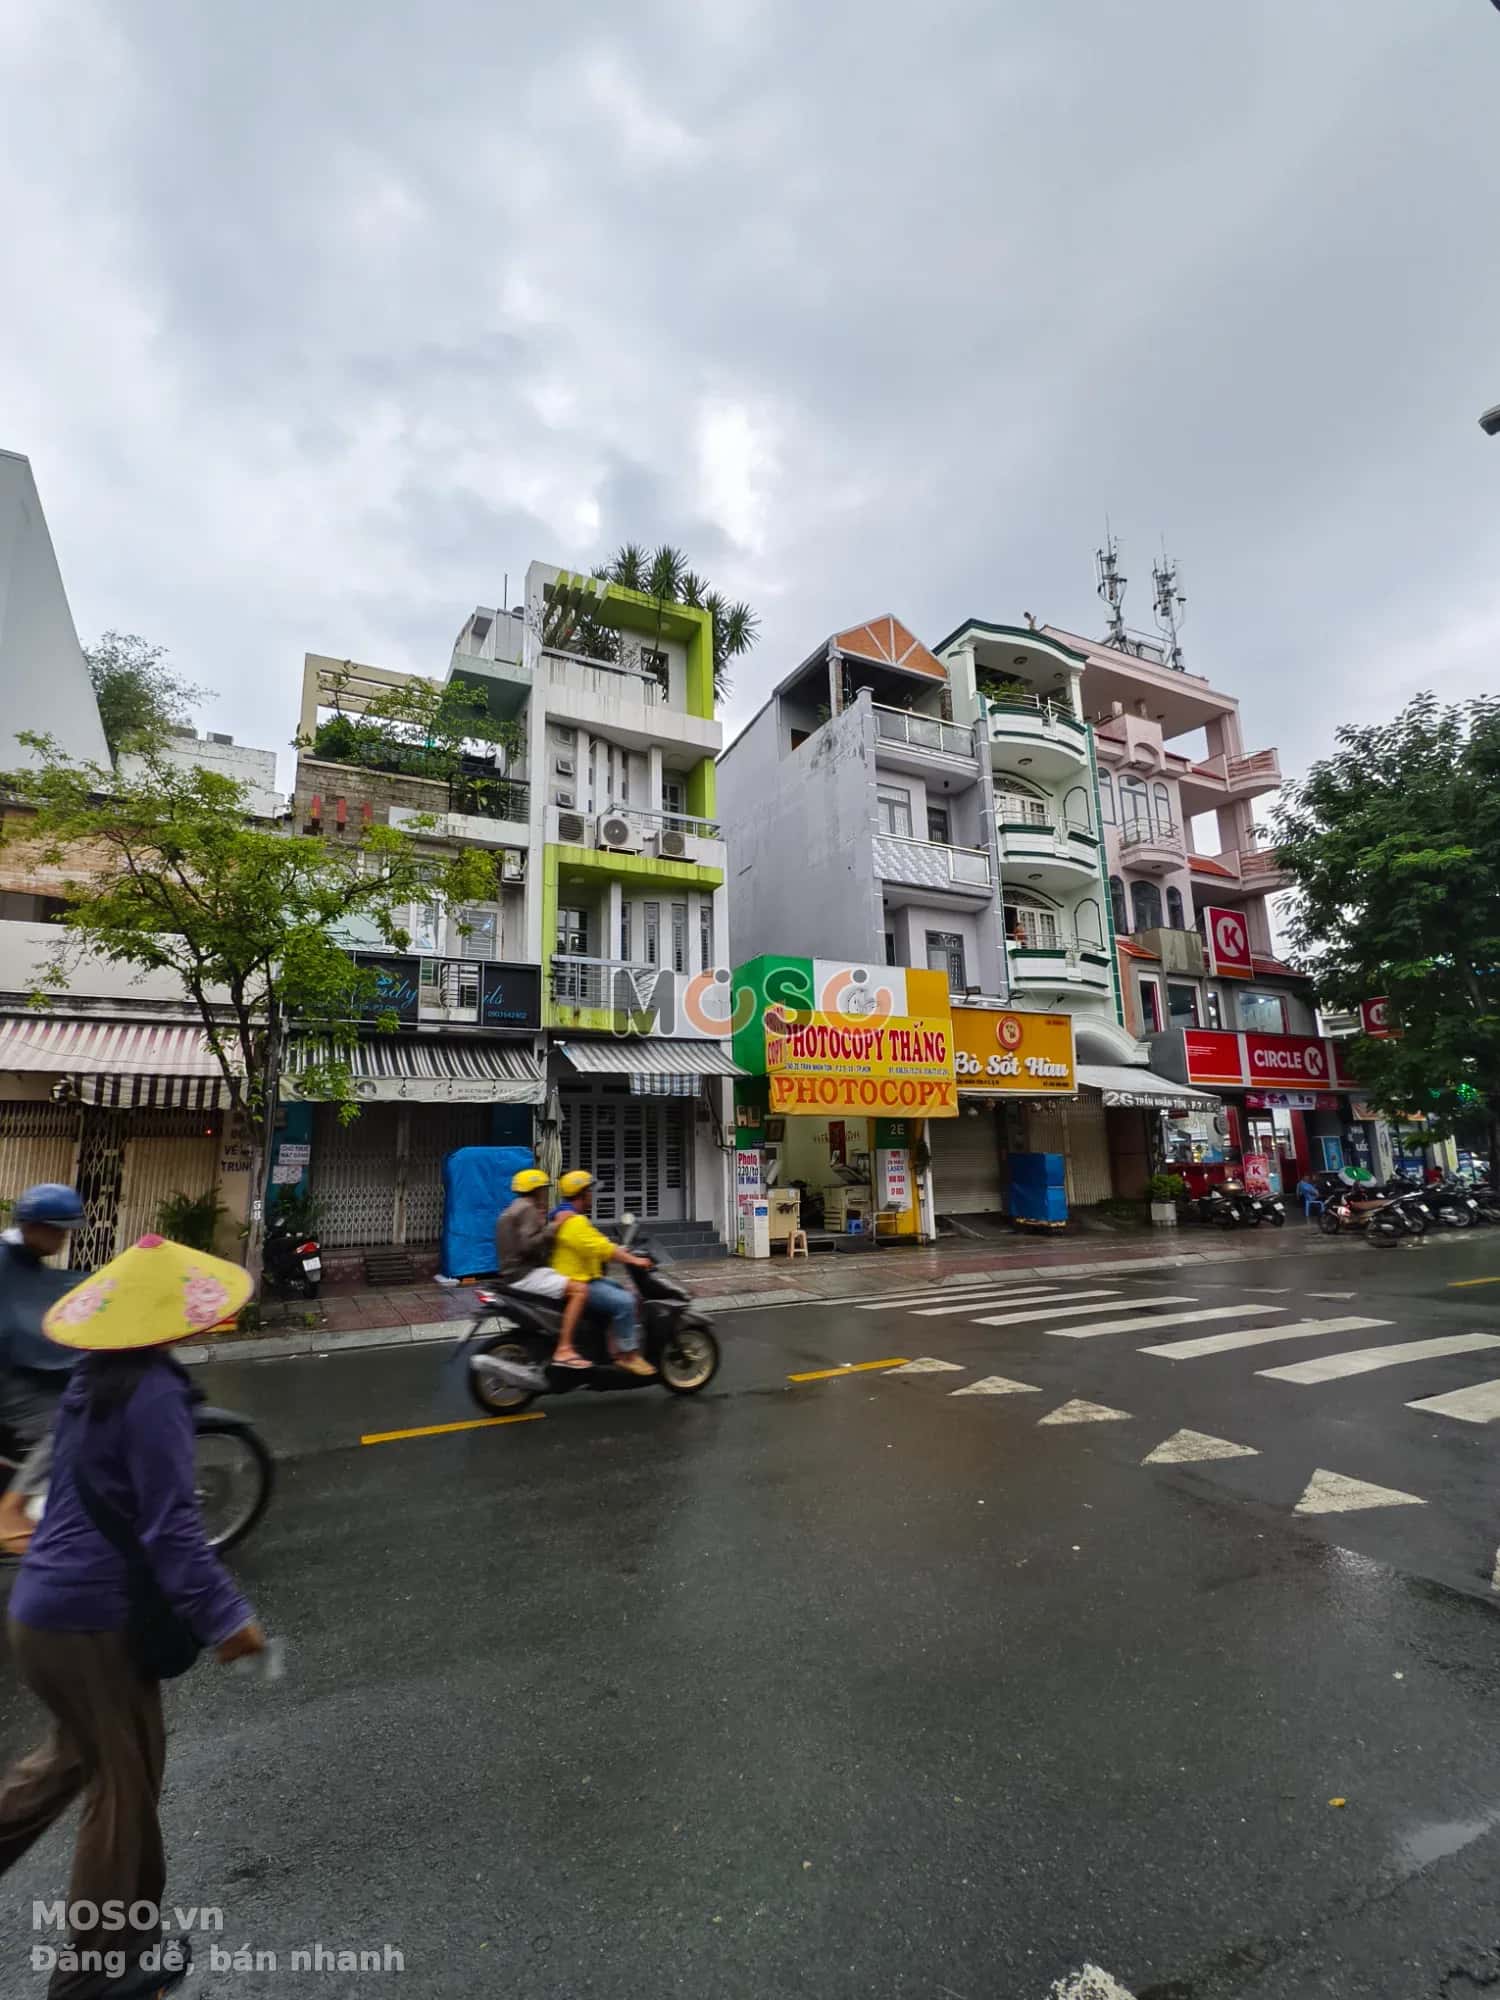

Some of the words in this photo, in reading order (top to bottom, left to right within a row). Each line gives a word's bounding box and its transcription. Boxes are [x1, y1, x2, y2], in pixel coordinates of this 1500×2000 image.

[1222, 923, 1243, 955] K
[889, 1021, 946, 1063] THẮNG
[986, 1051, 1021, 1076] Sốt
[1254, 1049, 1302, 1069] CIRCLE
[1308, 1049, 1322, 1073] K
[774, 1077, 952, 1106] PHOTOCOPY
[890, 1123, 905, 1135] 2E
[738, 1152, 758, 1166] Photo
